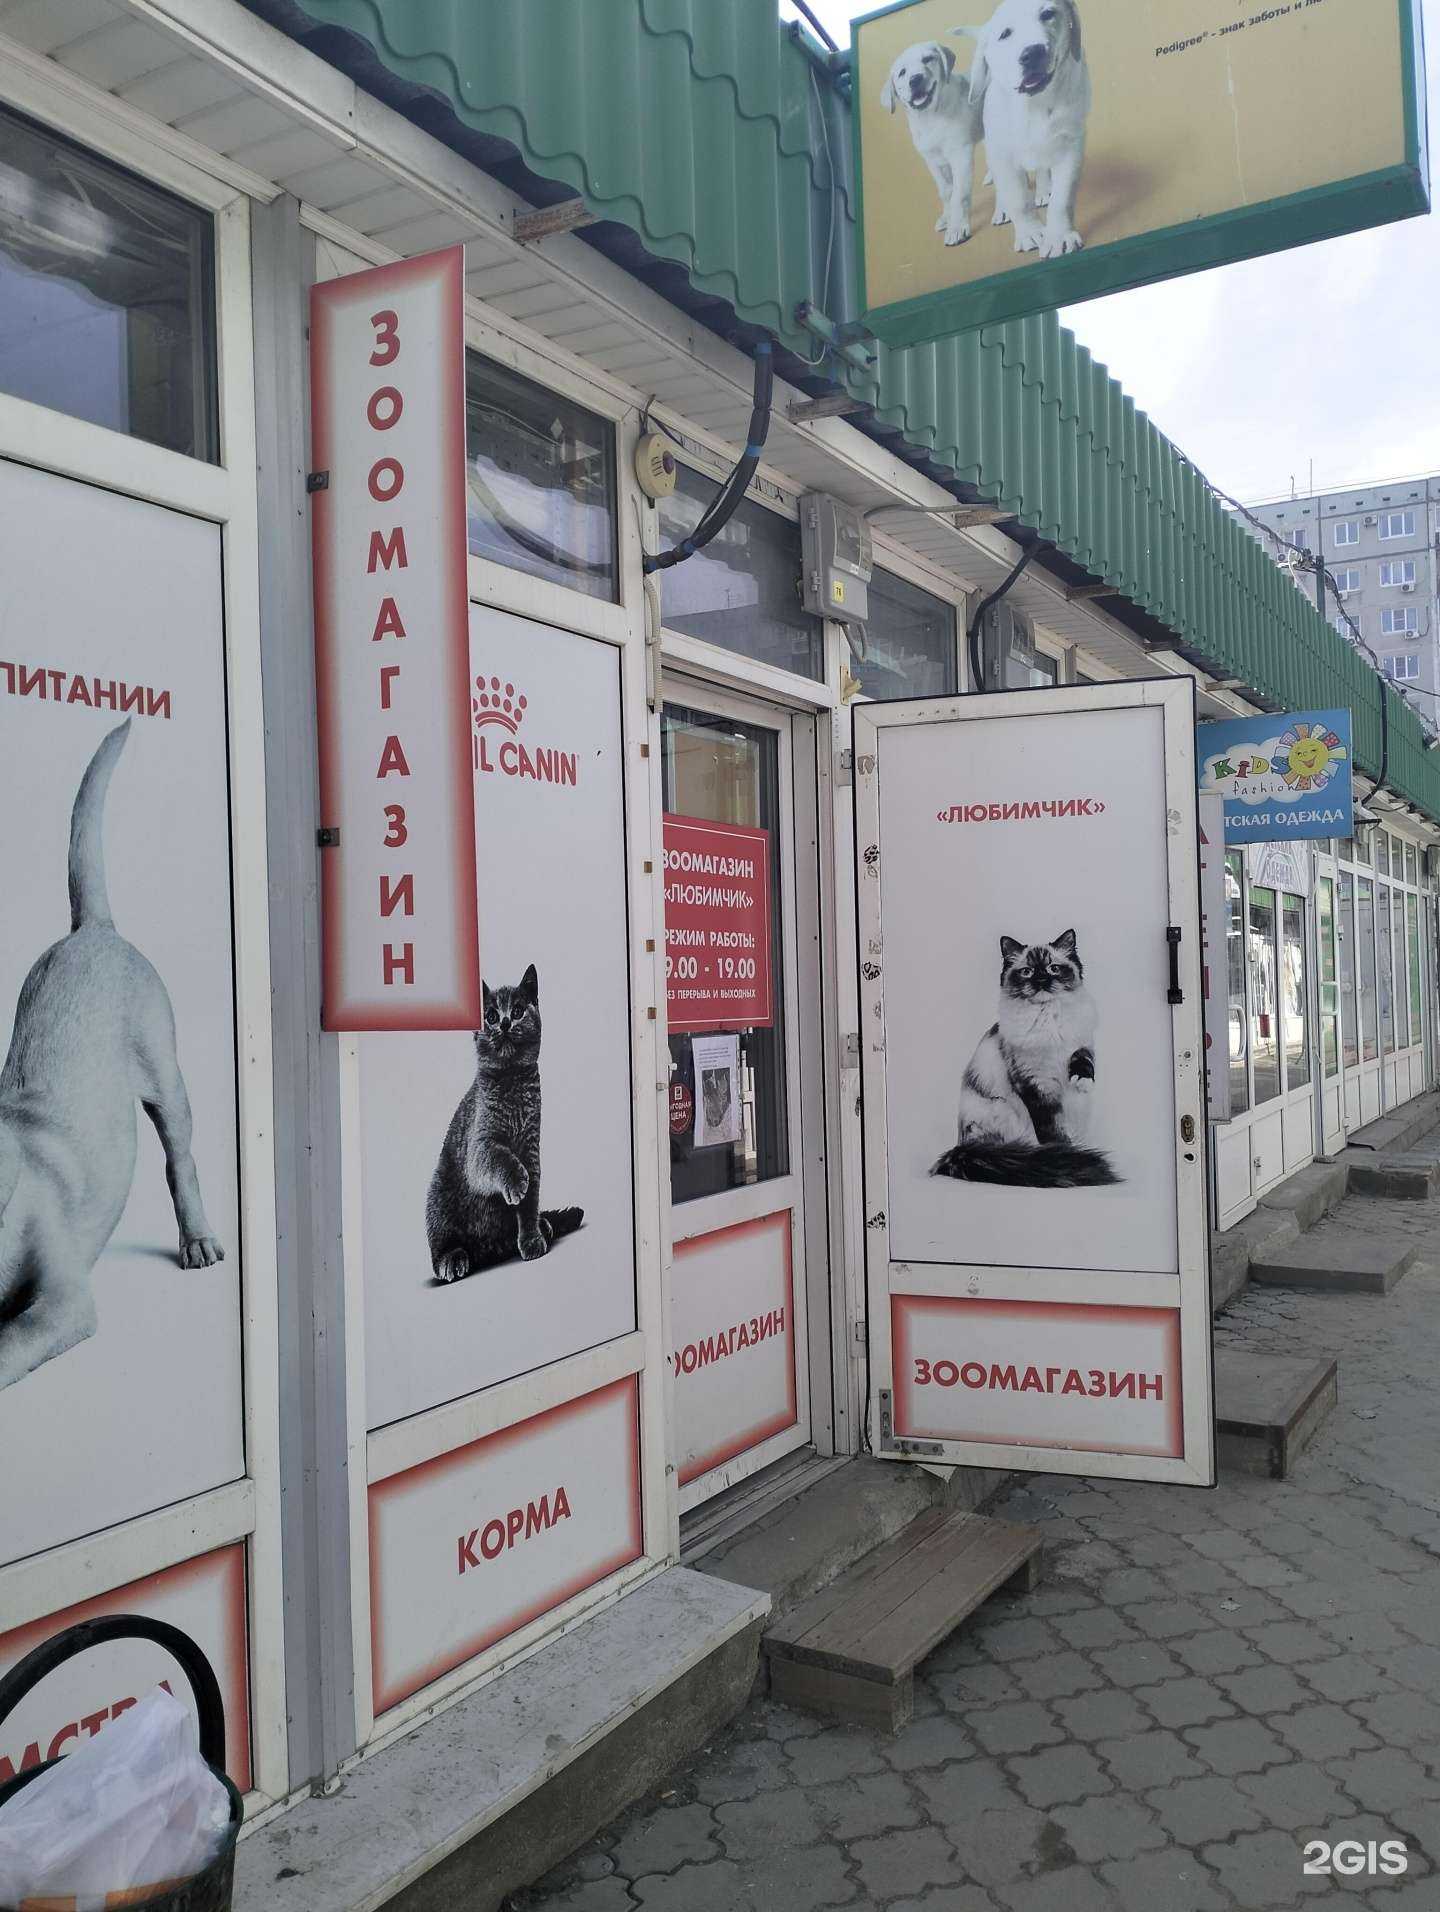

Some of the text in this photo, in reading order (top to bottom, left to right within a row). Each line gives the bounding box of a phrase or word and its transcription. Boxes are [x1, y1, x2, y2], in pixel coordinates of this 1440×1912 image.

[1219, 20, 1246, 36] знак
[1249, 5, 1291, 26] заботы
[367, 309, 415, 985] ЗООМАГАЗИН
[0, 660, 171, 720] ПИТАНИИ
[499, 741, 577, 786] CANIN
[1232, 780, 1297, 796] fashion
[936, 798, 1106, 824] «ЛЮБИМЧИК»
[1274, 808, 1345, 826] ОДЕЖДА
[664, 883, 754, 909] «ЛЮБИМЧИК»
[710, 931, 755, 949] РАБОТЫ:
[717, 957, 756, 979] 19.00
[666, 988, 756, 1000] ЕЗ ПЕРЕРЫВА И ВЫХОДНЫХ
[670, 1110, 687, 1121] ЦЕНА
[914, 1358, 1164, 1401] ЗООМАГАЗИН
[457, 1486, 572, 1575] КОРМА
